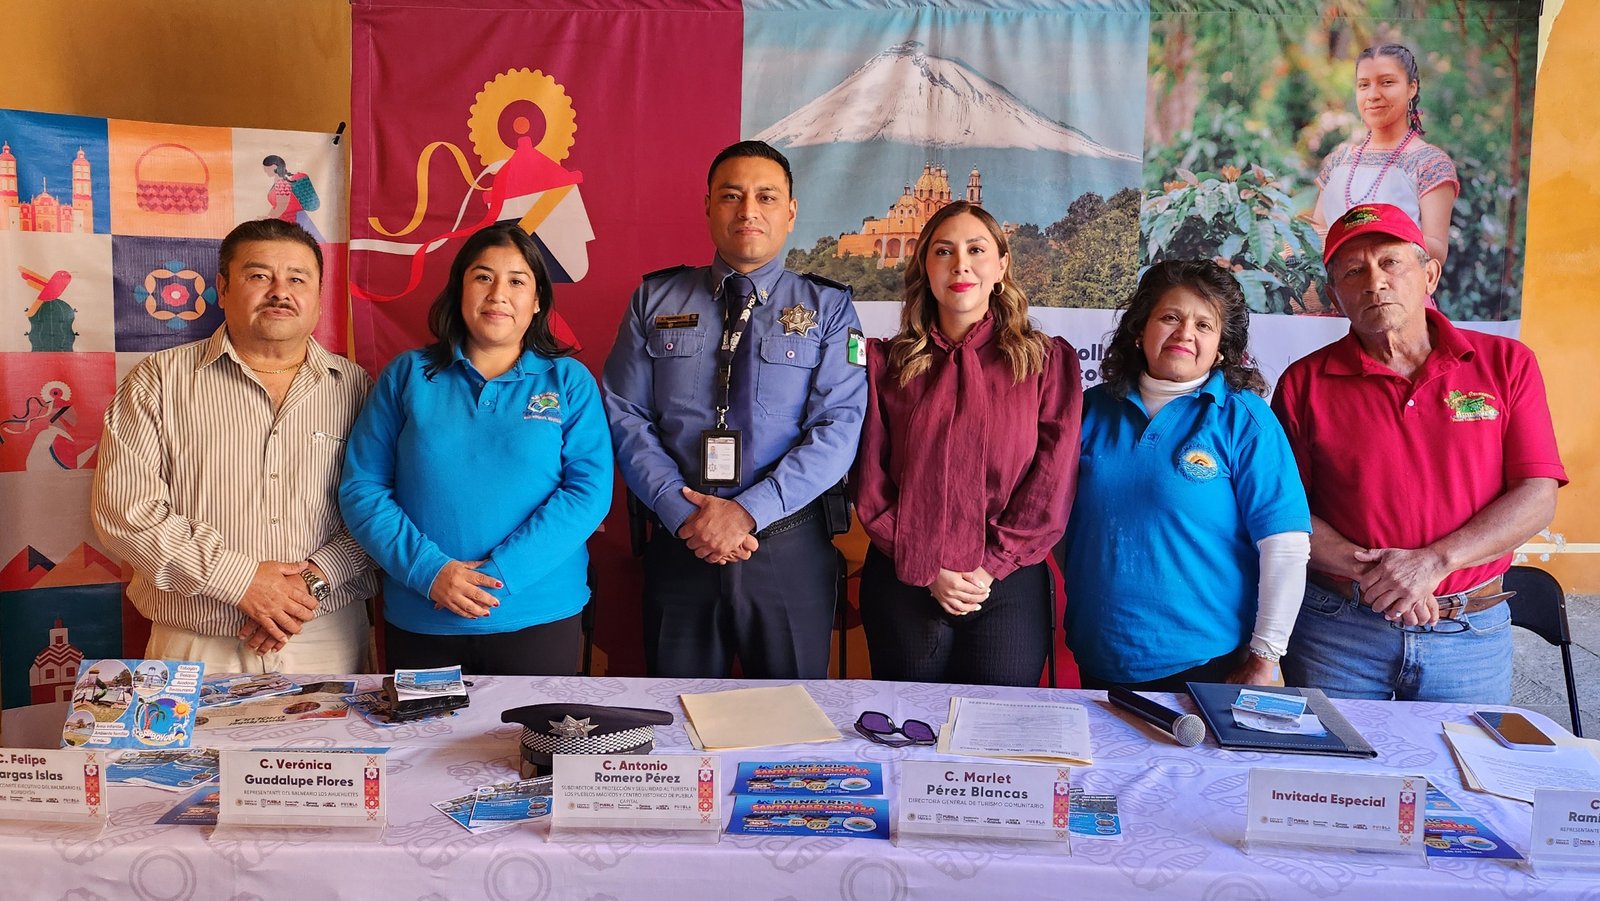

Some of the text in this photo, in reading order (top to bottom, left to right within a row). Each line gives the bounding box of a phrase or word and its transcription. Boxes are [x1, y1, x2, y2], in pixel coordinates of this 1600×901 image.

[11, 754, 47, 767] Felipe
[259, 758, 332, 770] C. Verónica
[602, 760, 668, 771] C. Antonio
[0, 770, 63, 781] argas Islas
[244, 774, 354, 788] Guadalupe Flores
[594, 772, 680, 783] Romero Pérez
[944, 771, 1012, 784] C. Marlet
[926, 784, 1028, 799] Pérez Blancas
[1272, 790, 1386, 808] Invitada Especial
[1568, 811, 1600, 823] Rami
